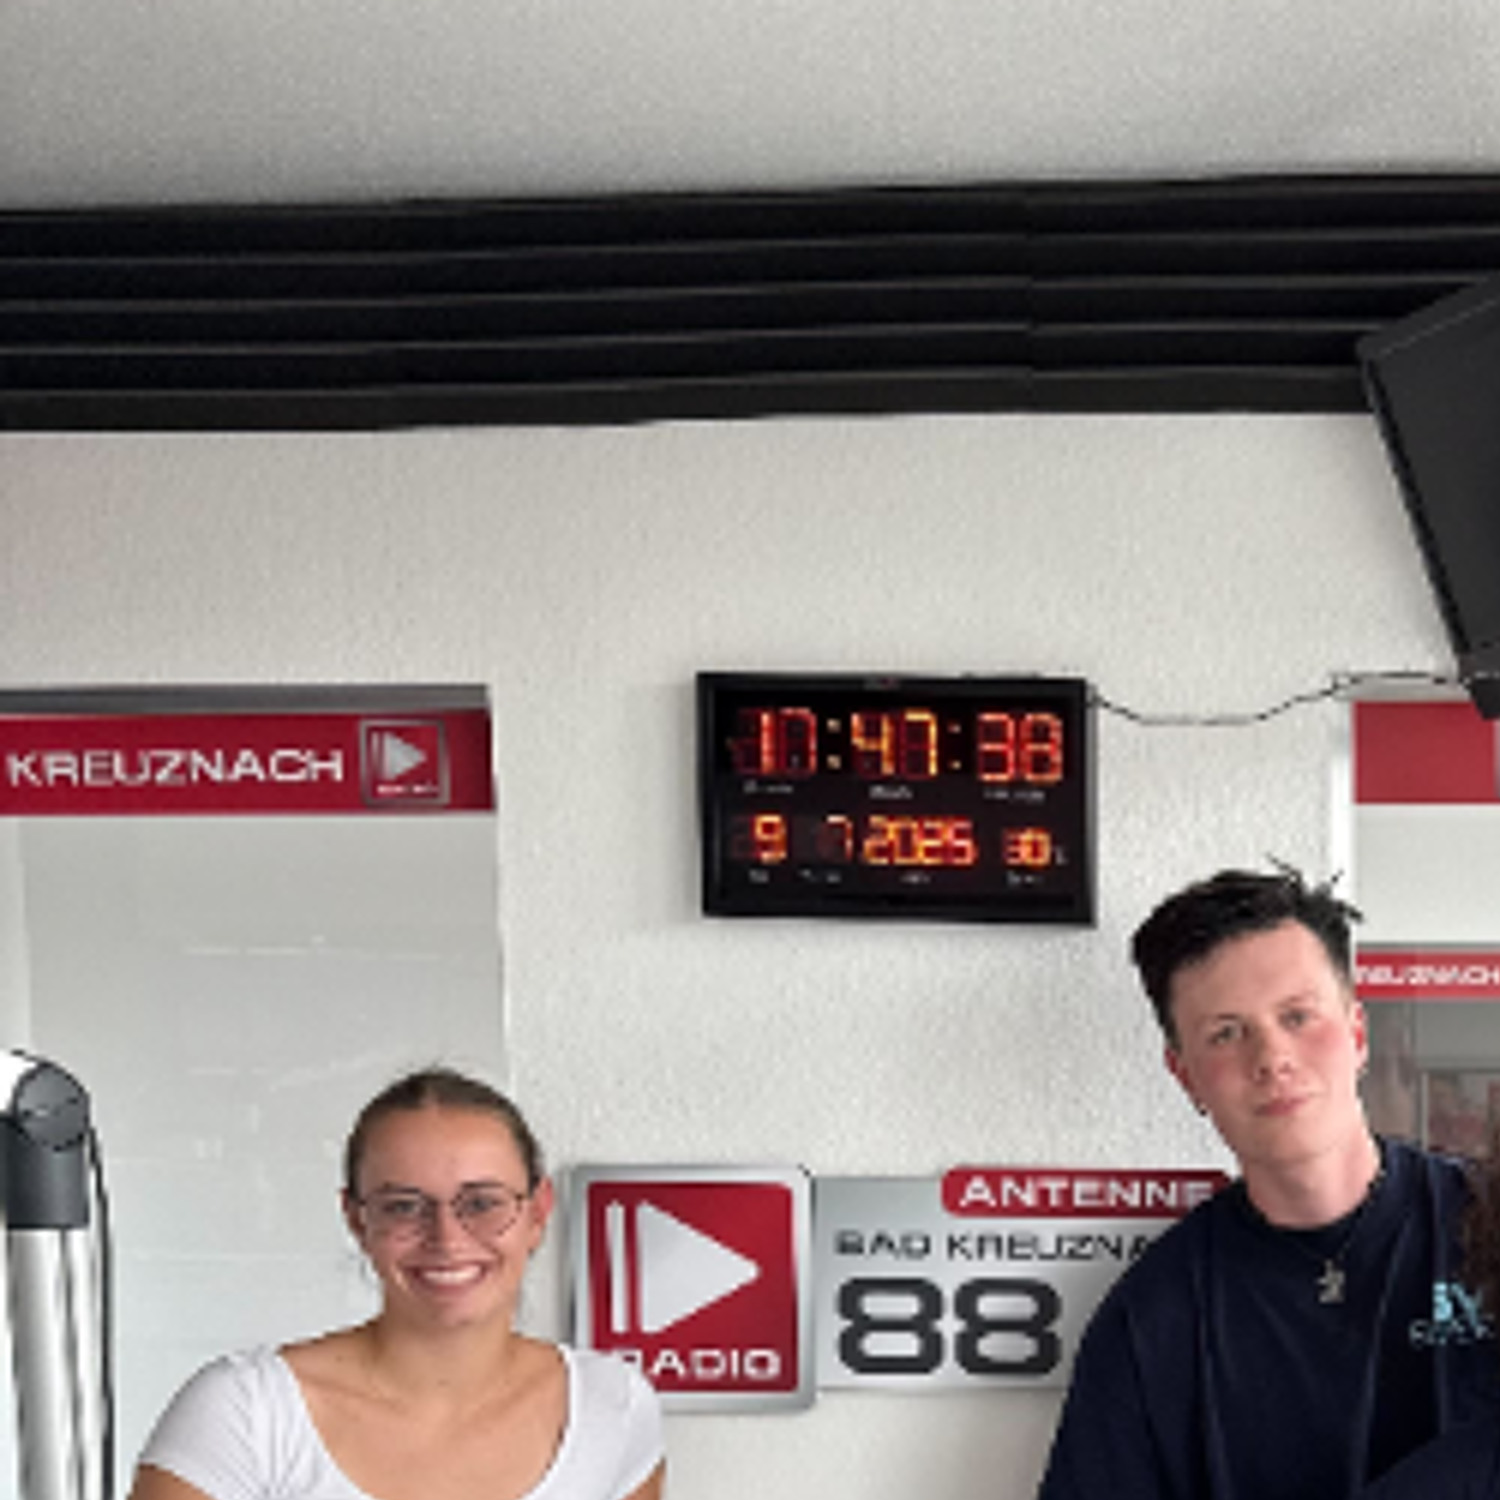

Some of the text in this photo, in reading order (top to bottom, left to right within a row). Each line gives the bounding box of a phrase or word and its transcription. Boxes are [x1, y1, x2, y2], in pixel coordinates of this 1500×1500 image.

[6, 748, 343, 787] KREUZNACH
[959, 1176, 1213, 1208] ANTENNE
[834, 1230, 931, 1257] BAD
[837, 1277, 1063, 1376] 88
